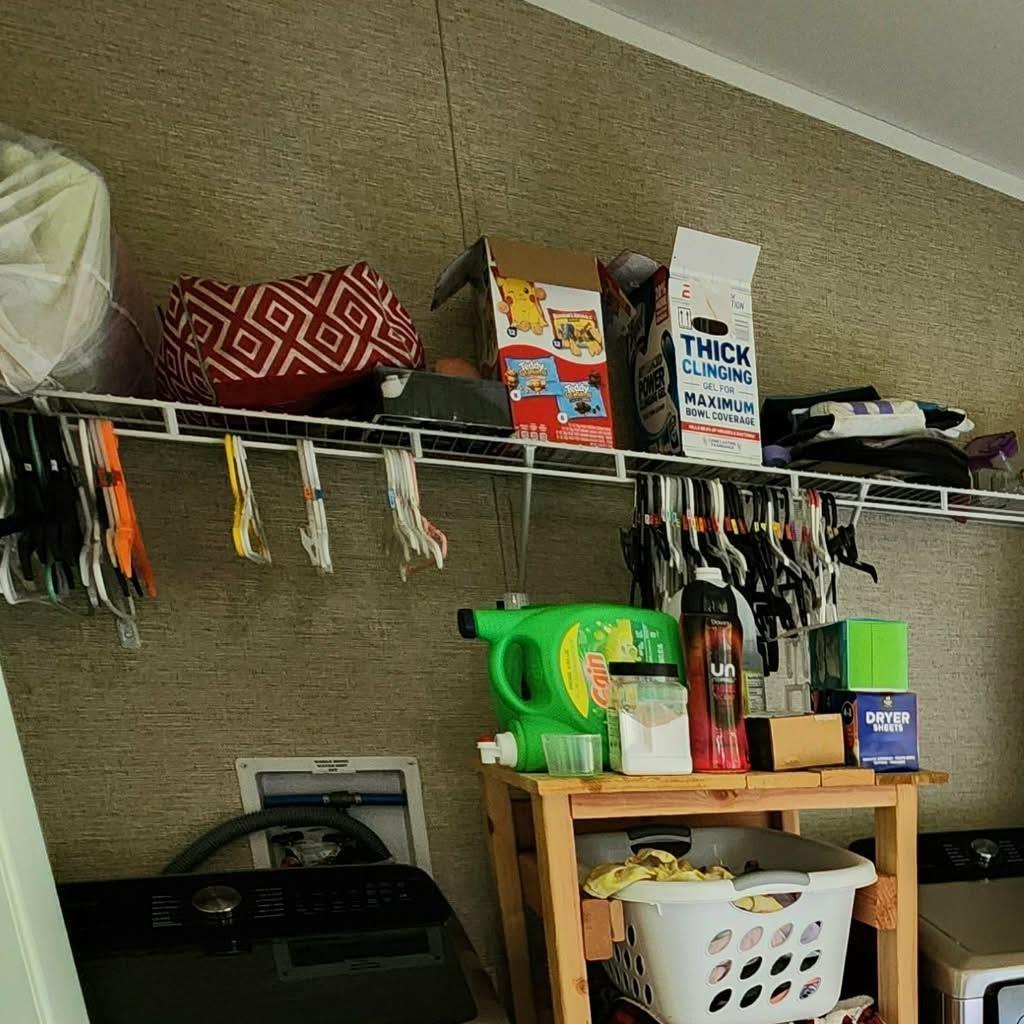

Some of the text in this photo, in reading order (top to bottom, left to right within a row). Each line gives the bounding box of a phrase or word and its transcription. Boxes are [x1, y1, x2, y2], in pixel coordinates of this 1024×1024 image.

[679, 333, 752, 368] THICK
[682, 358, 753, 385] CLINGING
[702, 381, 735, 395] GEL FOR
[684, 391, 755, 416] MAXIMUM
[685, 407, 755, 427] BOWL COVERAGE
[865, 711, 911, 725] DRYER
[872, 723, 904, 733] SHEETS
